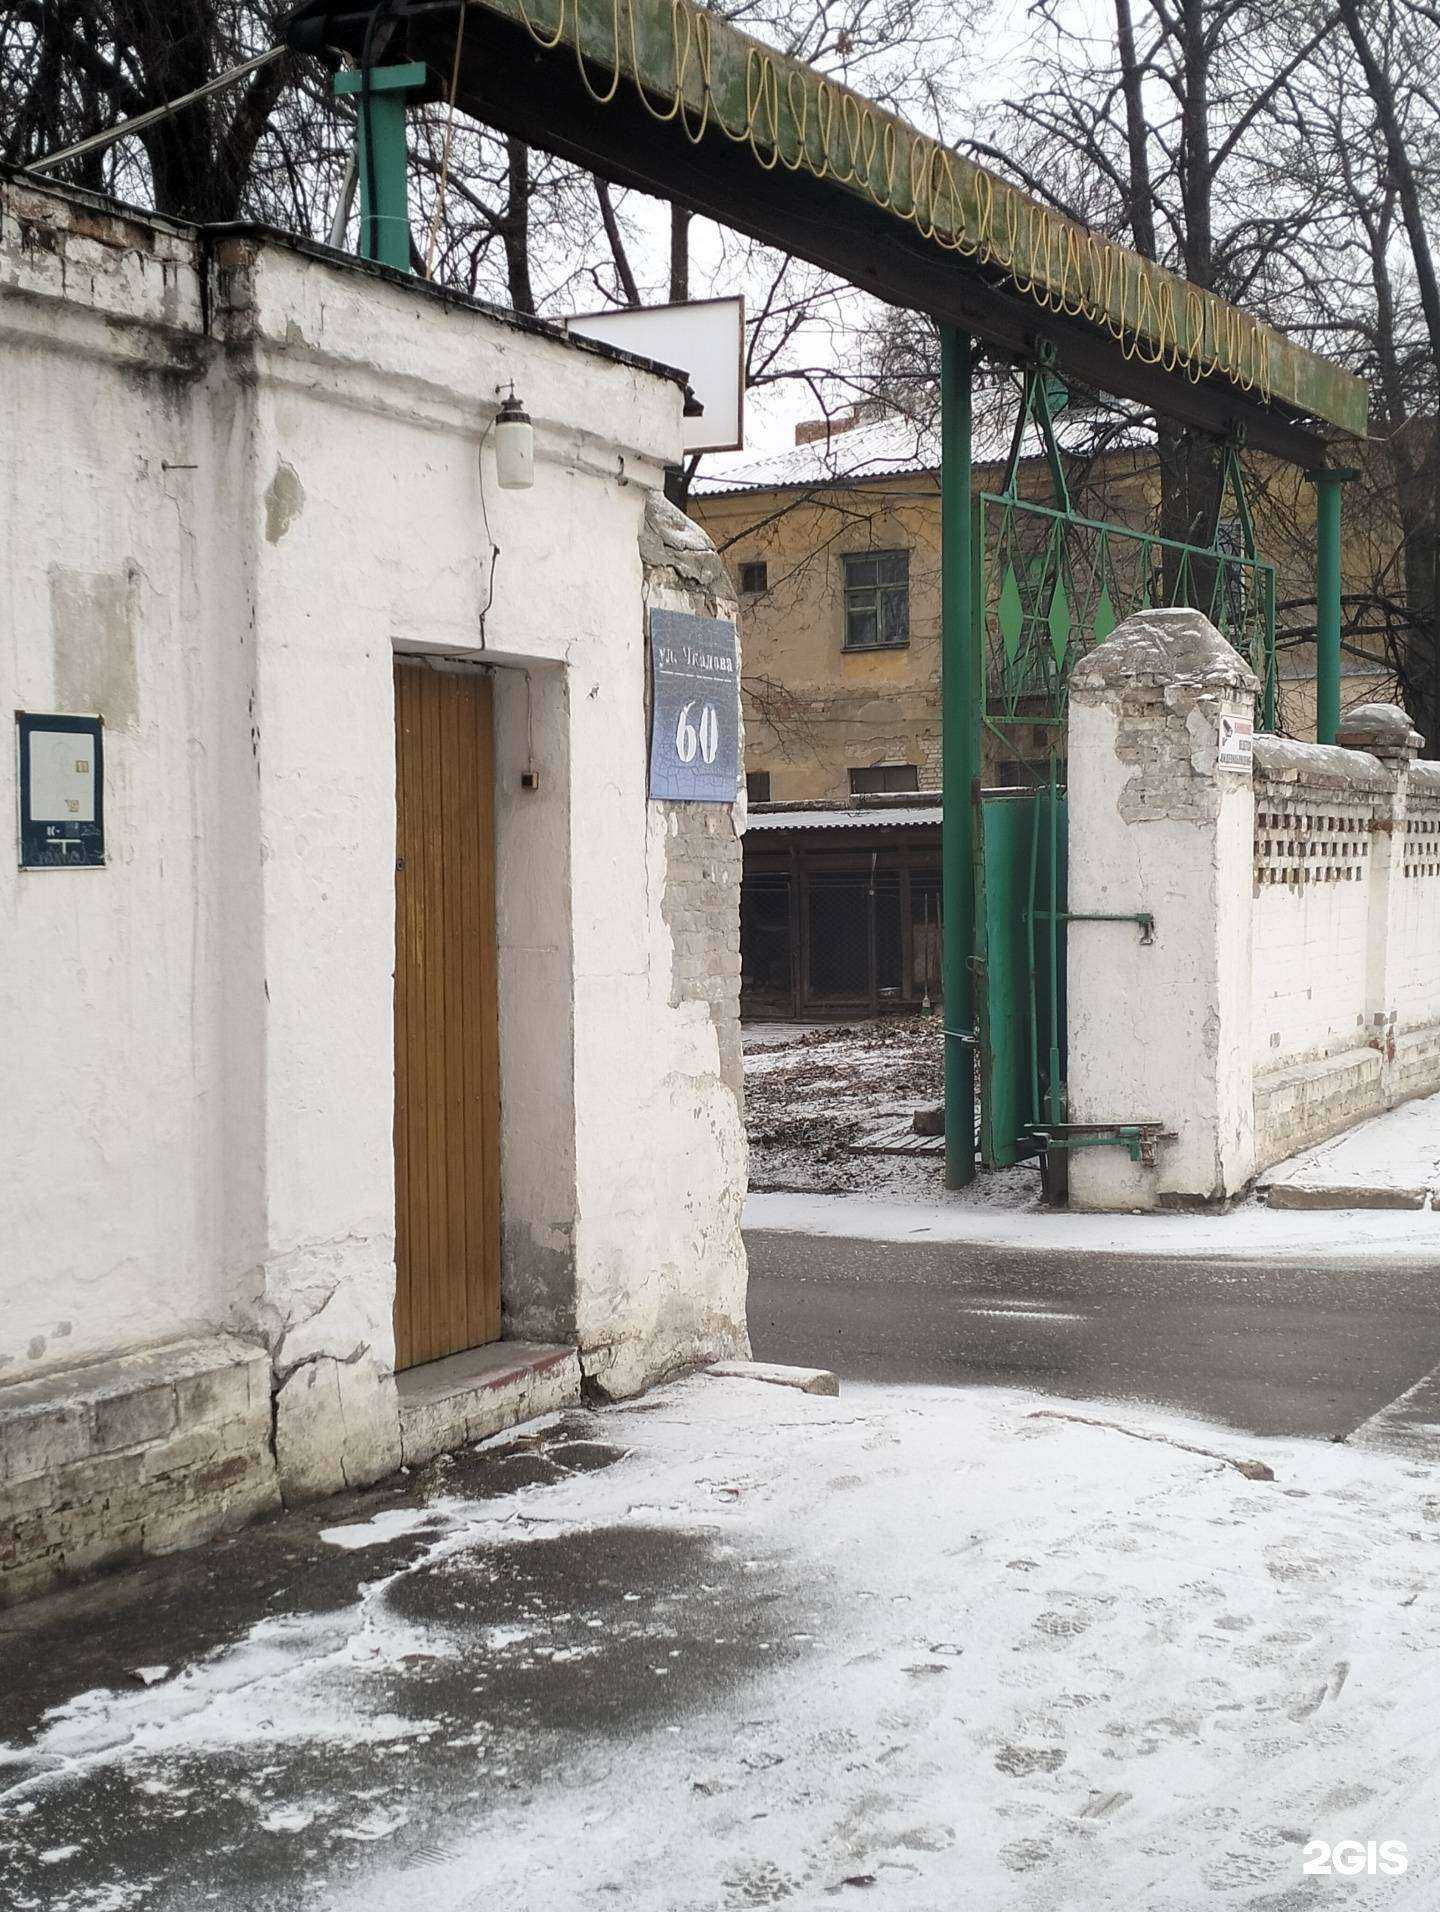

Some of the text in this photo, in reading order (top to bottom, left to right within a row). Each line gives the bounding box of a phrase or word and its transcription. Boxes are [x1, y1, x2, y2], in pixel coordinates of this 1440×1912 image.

[659, 646, 733, 672] ул. Чкалова
[676, 701, 718, 764] 60
